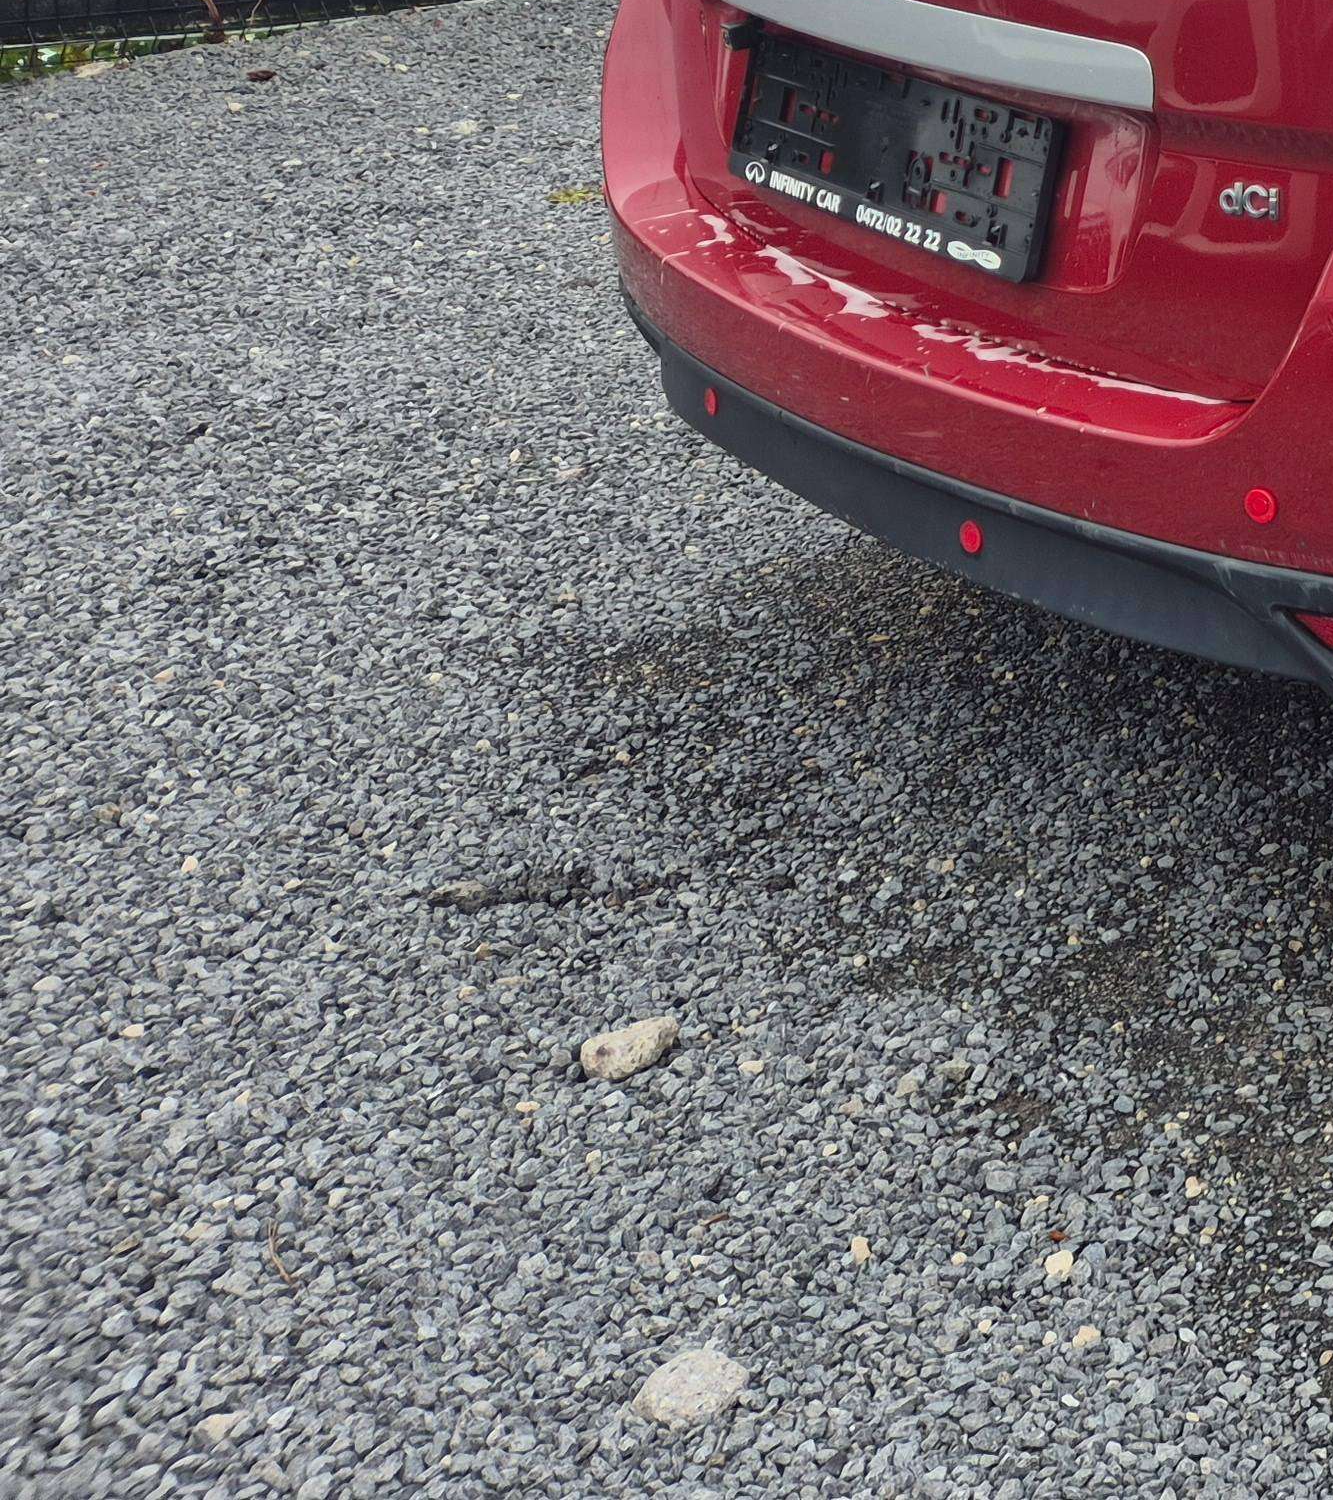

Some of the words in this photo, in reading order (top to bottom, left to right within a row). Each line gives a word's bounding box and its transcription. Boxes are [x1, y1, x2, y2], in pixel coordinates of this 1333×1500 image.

[769, 170, 817, 203] INFINITY
[815, 188, 842, 215] CAR
[855, 204, 903, 238] 0472/02
[903, 222, 923, 246] 22
[922, 228, 942, 253] 22
[1219, 182, 1279, 220] dCi
